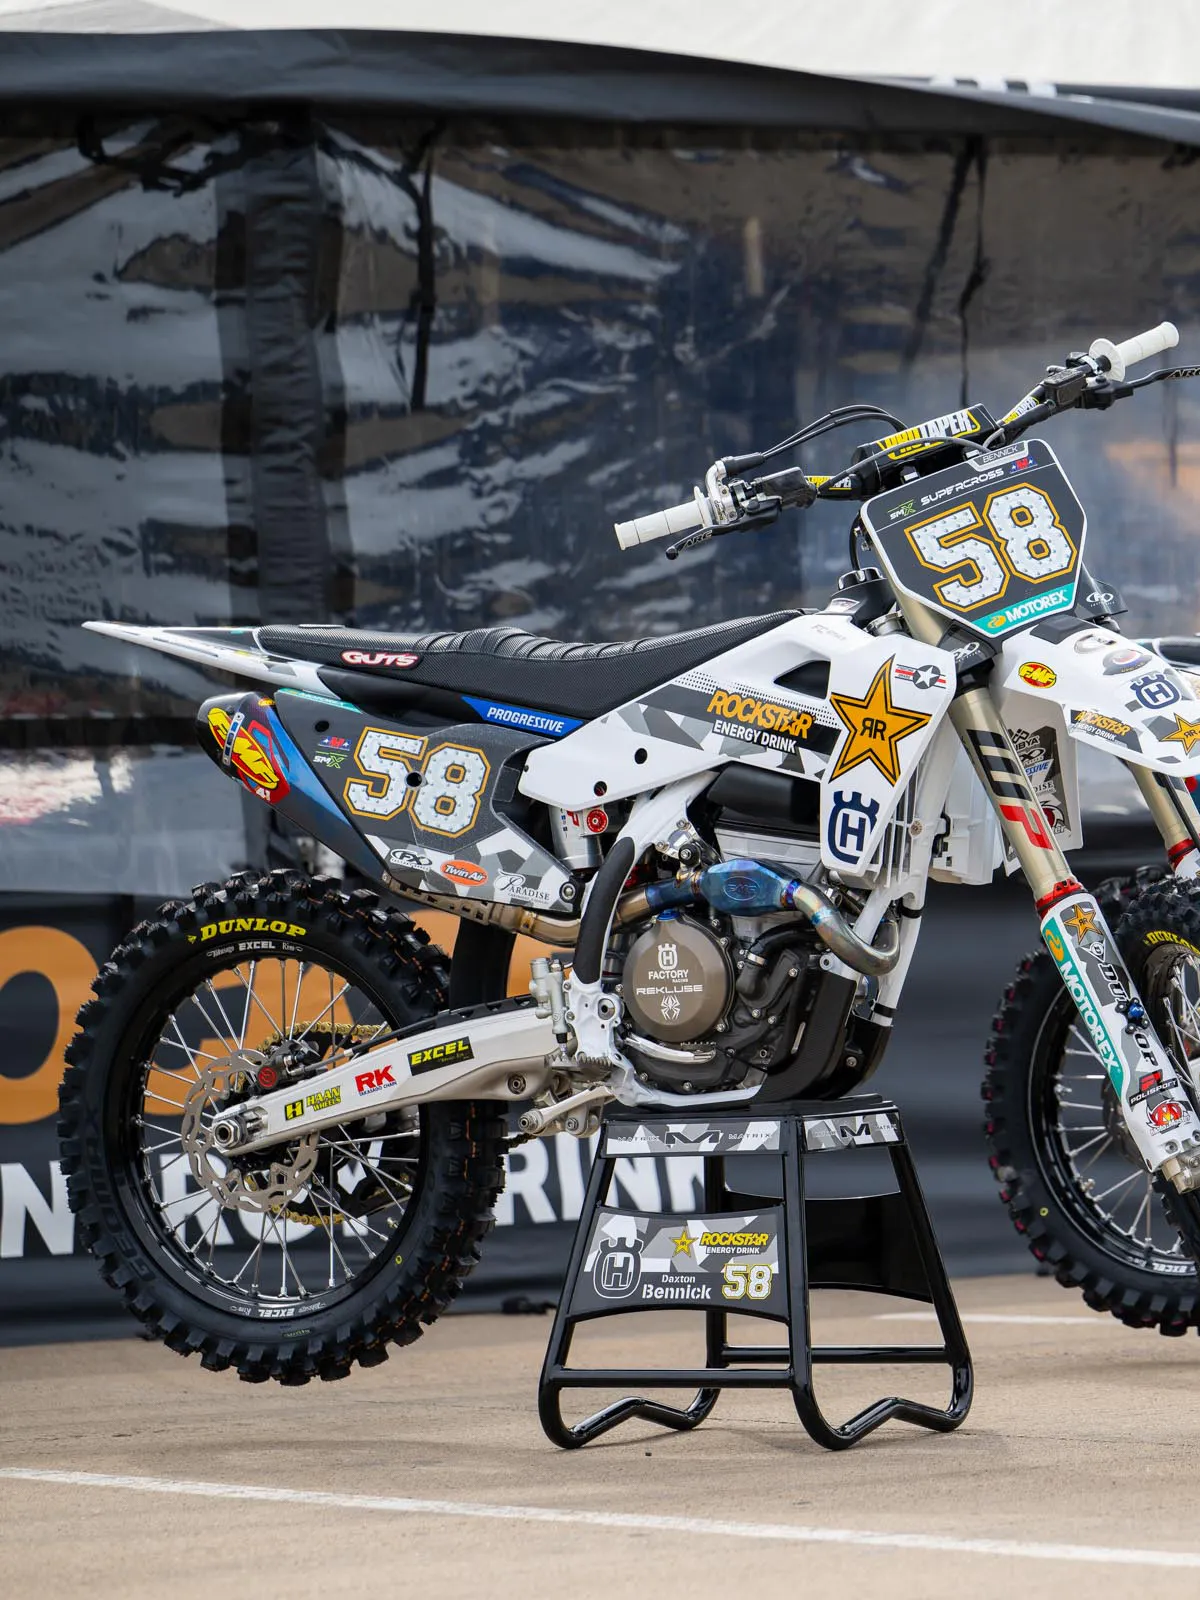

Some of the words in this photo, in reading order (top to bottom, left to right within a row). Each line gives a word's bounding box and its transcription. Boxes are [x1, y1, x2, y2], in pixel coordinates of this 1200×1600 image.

[983, 446, 1019, 463] BENNICK
[889, 500, 916, 520] SMX
[920, 468, 1005, 506] SUPERCROSS
[903, 482, 1078, 612] 58
[1005, 589, 1068, 623] MOTOREX
[340, 650, 419, 667] GUTS
[1019, 663, 1058, 688] FMF
[487, 706, 565, 734] PROGRESSIVE
[706, 690, 814, 740] ROCKSTAR
[713, 719, 761, 744] ENERGY
[760, 733, 798, 755] DRINK
[1095, 728, 1117, 742] DRINK
[313, 750, 348, 769] SMX
[343, 726, 491, 838] 58
[445, 864, 470, 879] Twin
[469, 871, 486, 882] Air
[494, 868, 550, 901] PARADISE
[200, 917, 308, 942] DUNLOP
[238, 941, 276, 951] EXCEL
[648, 969, 689, 980] FACTORY
[636, 984, 704, 996] REKLUSE
[1059, 961, 1119, 1072] MOTOREX
[411, 1039, 470, 1065] EXCEL
[355, 1065, 396, 1094] RK
[382, 1081, 398, 1090] CHAIN
[306, 1085, 341, 1108] HAAN
[1130, 1080, 1178, 1104] POLISPORT
[312, 1096, 341, 1112] WHEELS
[700, 1232, 770, 1247] ROCKSTAR
[706, 1246, 735, 1254] ENERGY
[736, 1246, 760, 1254] DRINK
[661, 1274, 696, 1284] Daxton
[721, 1263, 774, 1299] 58
[642, 1284, 712, 1300] Bennick
[258, 1308, 296, 1318] EXCEL
